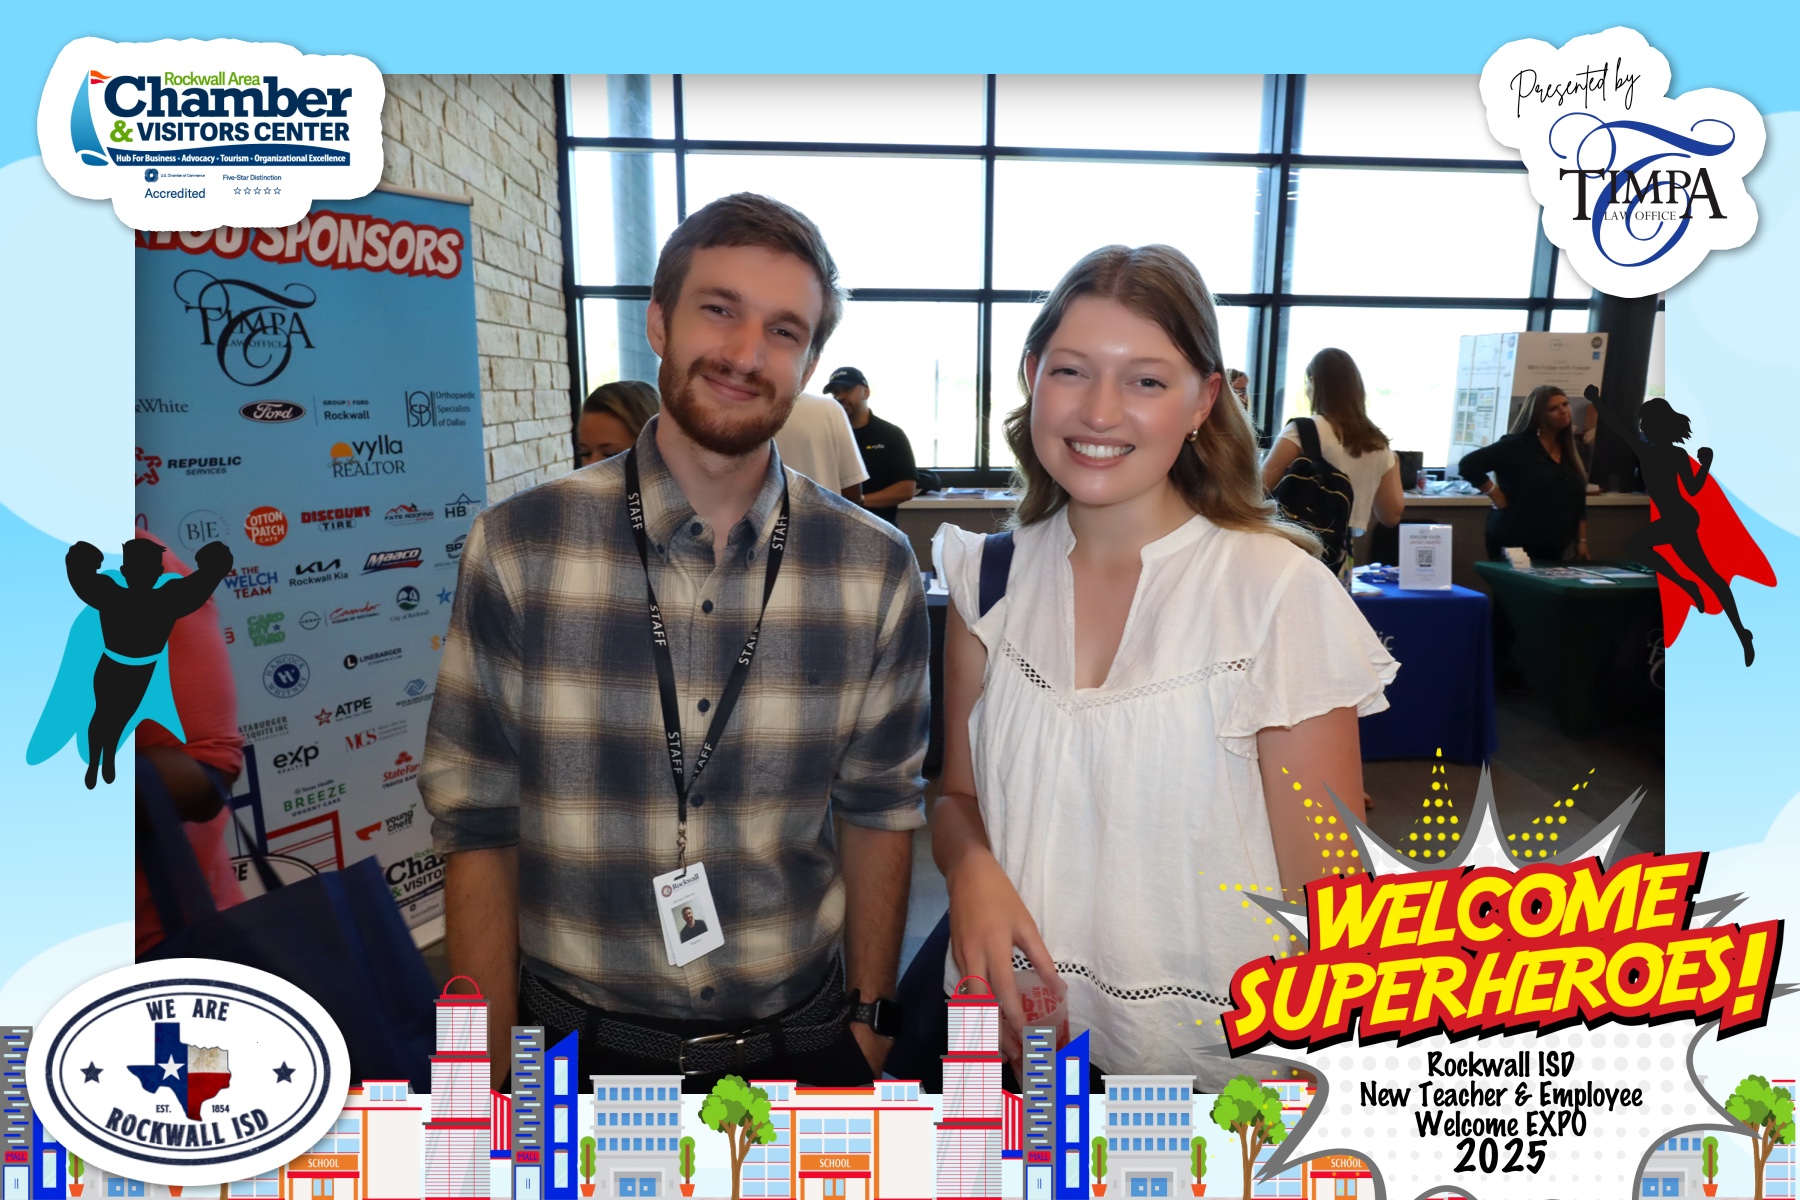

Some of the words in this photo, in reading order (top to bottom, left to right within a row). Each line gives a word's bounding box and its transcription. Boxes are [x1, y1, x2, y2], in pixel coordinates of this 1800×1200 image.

[257, 215, 460, 274] SPONSORS
[435, 391, 475, 400] Orthopaedic
[253, 403, 293, 419] Ford
[324, 410, 370, 420] Rockwall
[437, 405, 471, 414] Specialists
[352, 435, 403, 461] vylla
[167, 456, 242, 469] REPUBLIC
[186, 467, 227, 476] SERVICES
[333, 460, 406, 478] REALTOR
[244, 510, 283, 530] COTTON
[301, 506, 370, 524] DISCOUNT
[404, 511, 434, 519] ROOFING
[628, 492, 643, 531] STAFF
[322, 520, 353, 530] TIRE
[772, 514, 788, 550] STAFF
[251, 525, 285, 544] PATCH
[366, 549, 420, 568] Maaco
[241, 566, 259, 574] THE
[224, 572, 278, 588] WELCH
[289, 574, 332, 587] Rockwall
[334, 572, 349, 580] Kia
[233, 586, 271, 599] TEAM
[650, 604, 667, 647] STAFF
[359, 648, 402, 663] LINEBARGER
[266, 655, 306, 677] HANCOCK
[268, 677, 307, 696] WHITNEY
[335, 697, 372, 718] ATPE
[275, 723, 288, 732] INC
[667, 731, 683, 774] STAFF
[284, 783, 346, 812] BREEZE
[292, 805, 321, 817] URGENT
[322, 798, 341, 807] CARE
[385, 809, 414, 827] young
[387, 819, 413, 832] chefs
[672, 873, 700, 890] Rockwall
